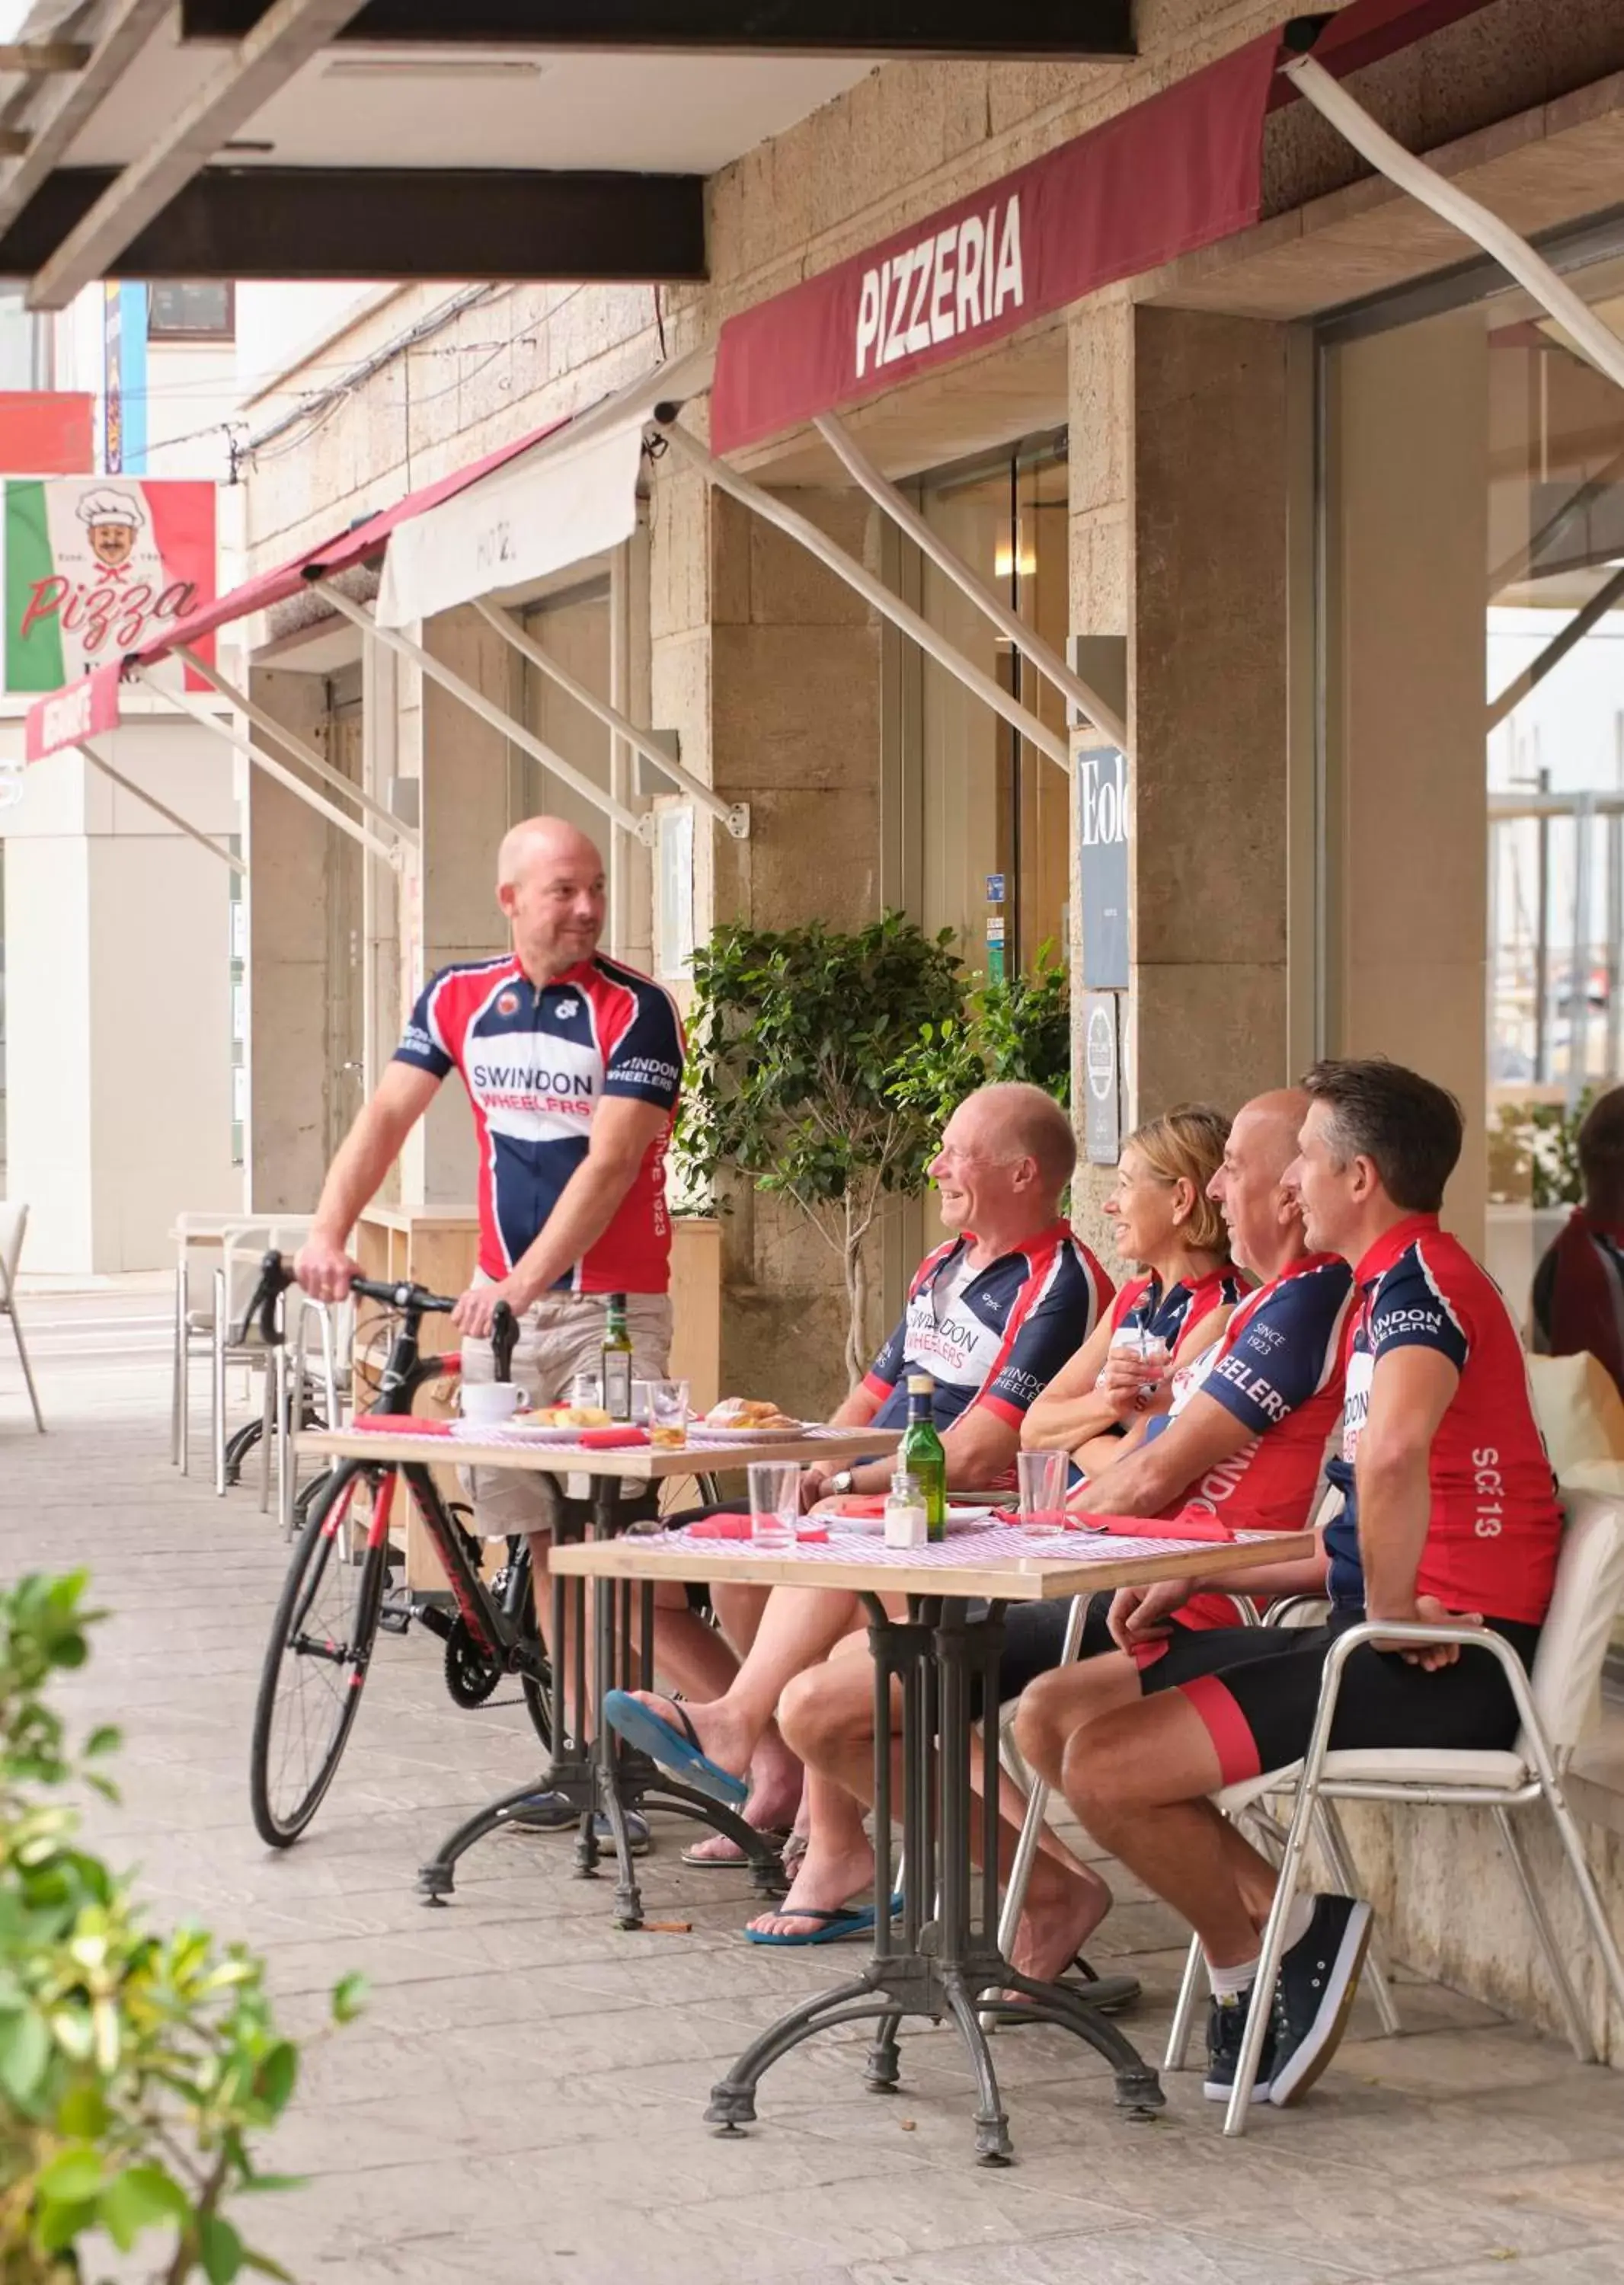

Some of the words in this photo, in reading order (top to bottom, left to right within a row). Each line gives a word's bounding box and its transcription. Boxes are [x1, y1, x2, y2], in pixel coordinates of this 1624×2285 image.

[855, 194, 1024, 379] PIZZERIA
[21, 575, 198, 651] Pizza
[474, 1064, 593, 1095] SWINDON
[482, 1091, 591, 1117] WHEELERS
[1246, 1334, 1271, 1356] 1923
[1254, 1322, 1287, 1347] SINCE
[1214, 1354, 1292, 1423] EELERS
